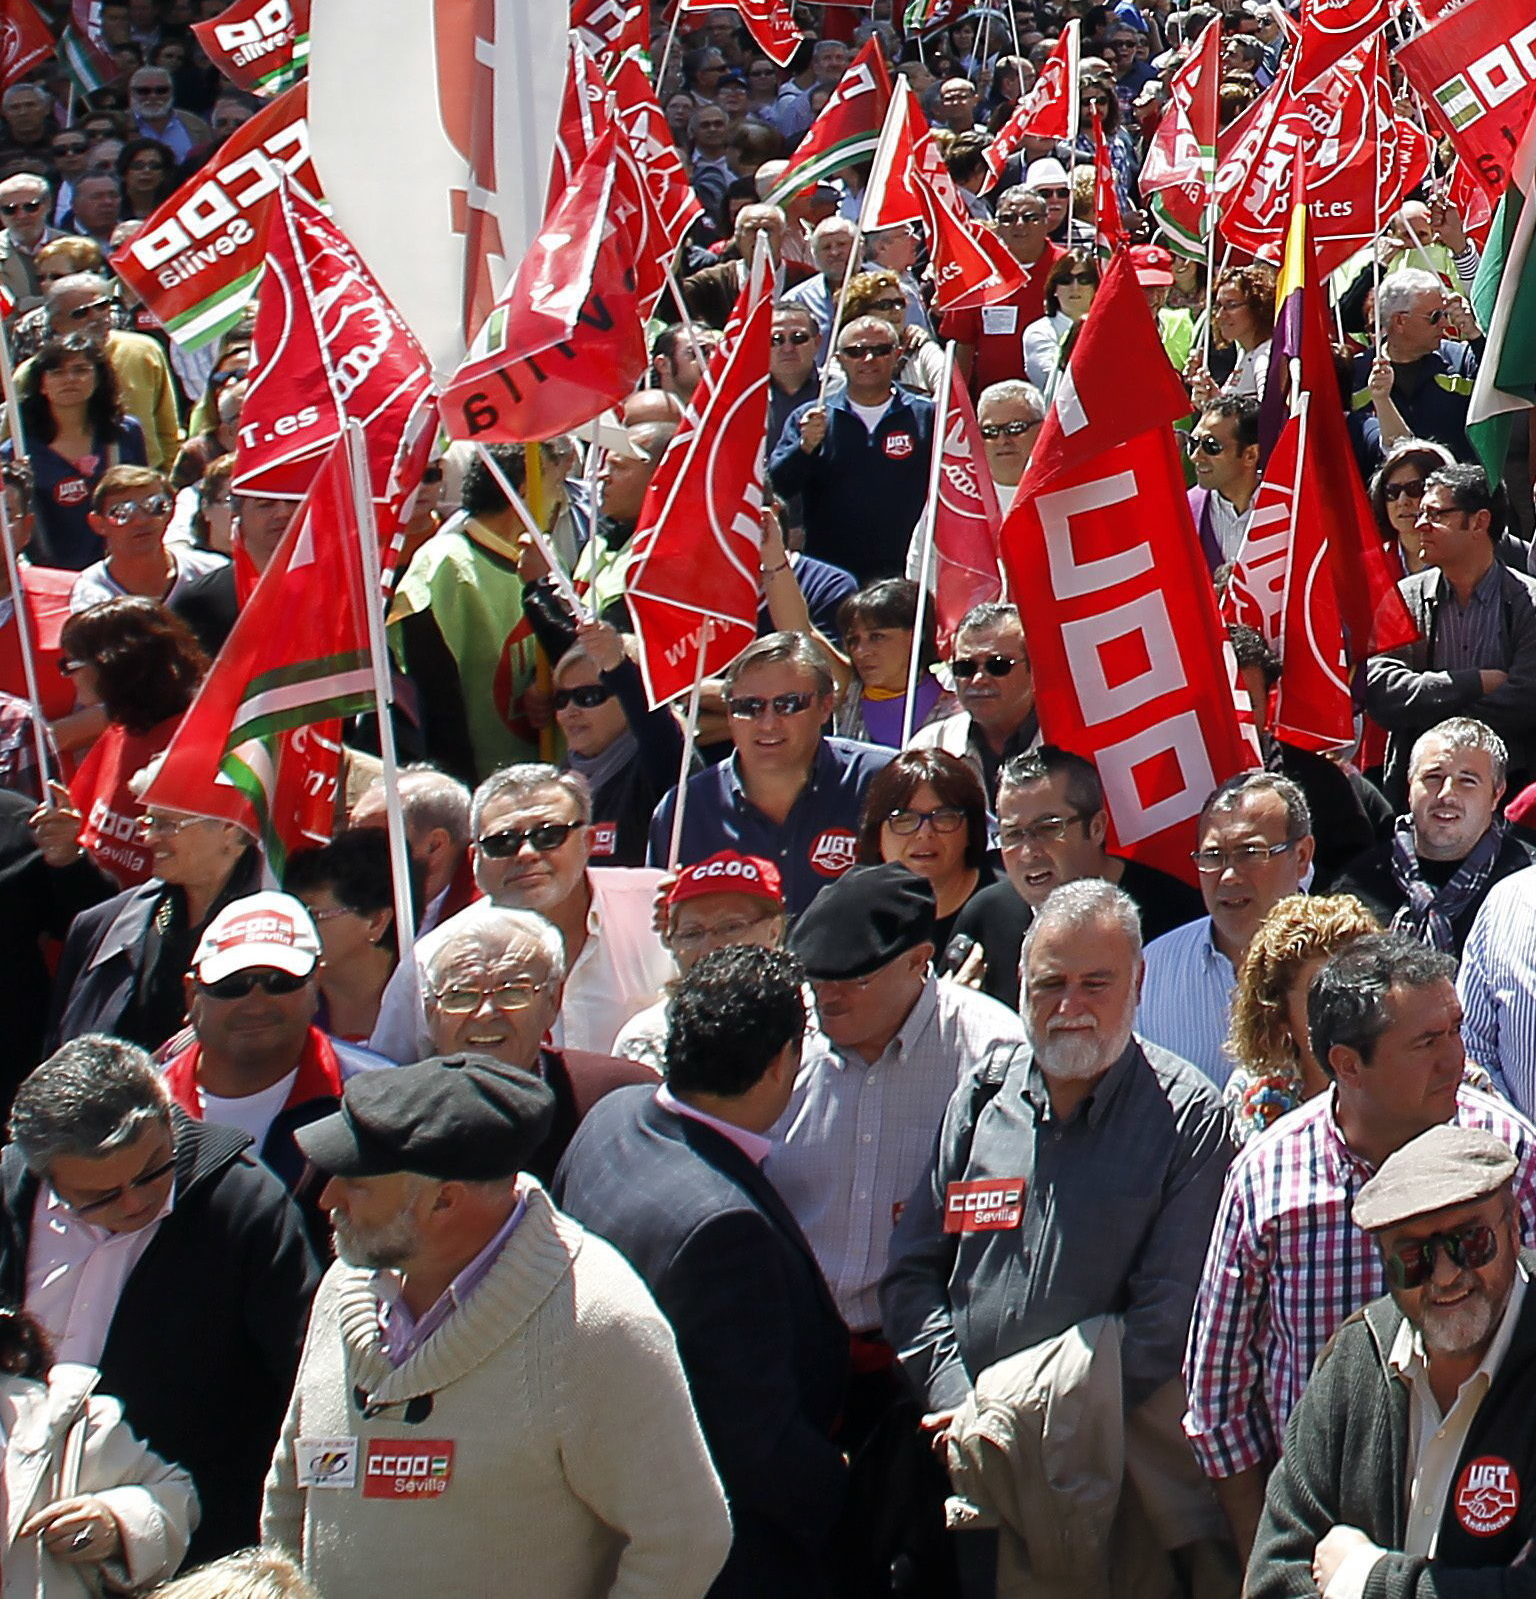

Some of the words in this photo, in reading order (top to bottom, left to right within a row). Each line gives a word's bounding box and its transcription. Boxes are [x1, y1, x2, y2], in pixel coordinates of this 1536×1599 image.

[886, 435, 912, 454] UGT
[814, 834, 856, 860] UGT
[949, 1191, 1004, 1212] CCOO
[974, 1207, 1018, 1224] Sevilla
[368, 1455, 428, 1476] CCOO
[393, 1477, 446, 1494] Sevilla
[1467, 1466, 1510, 1490] UGT
